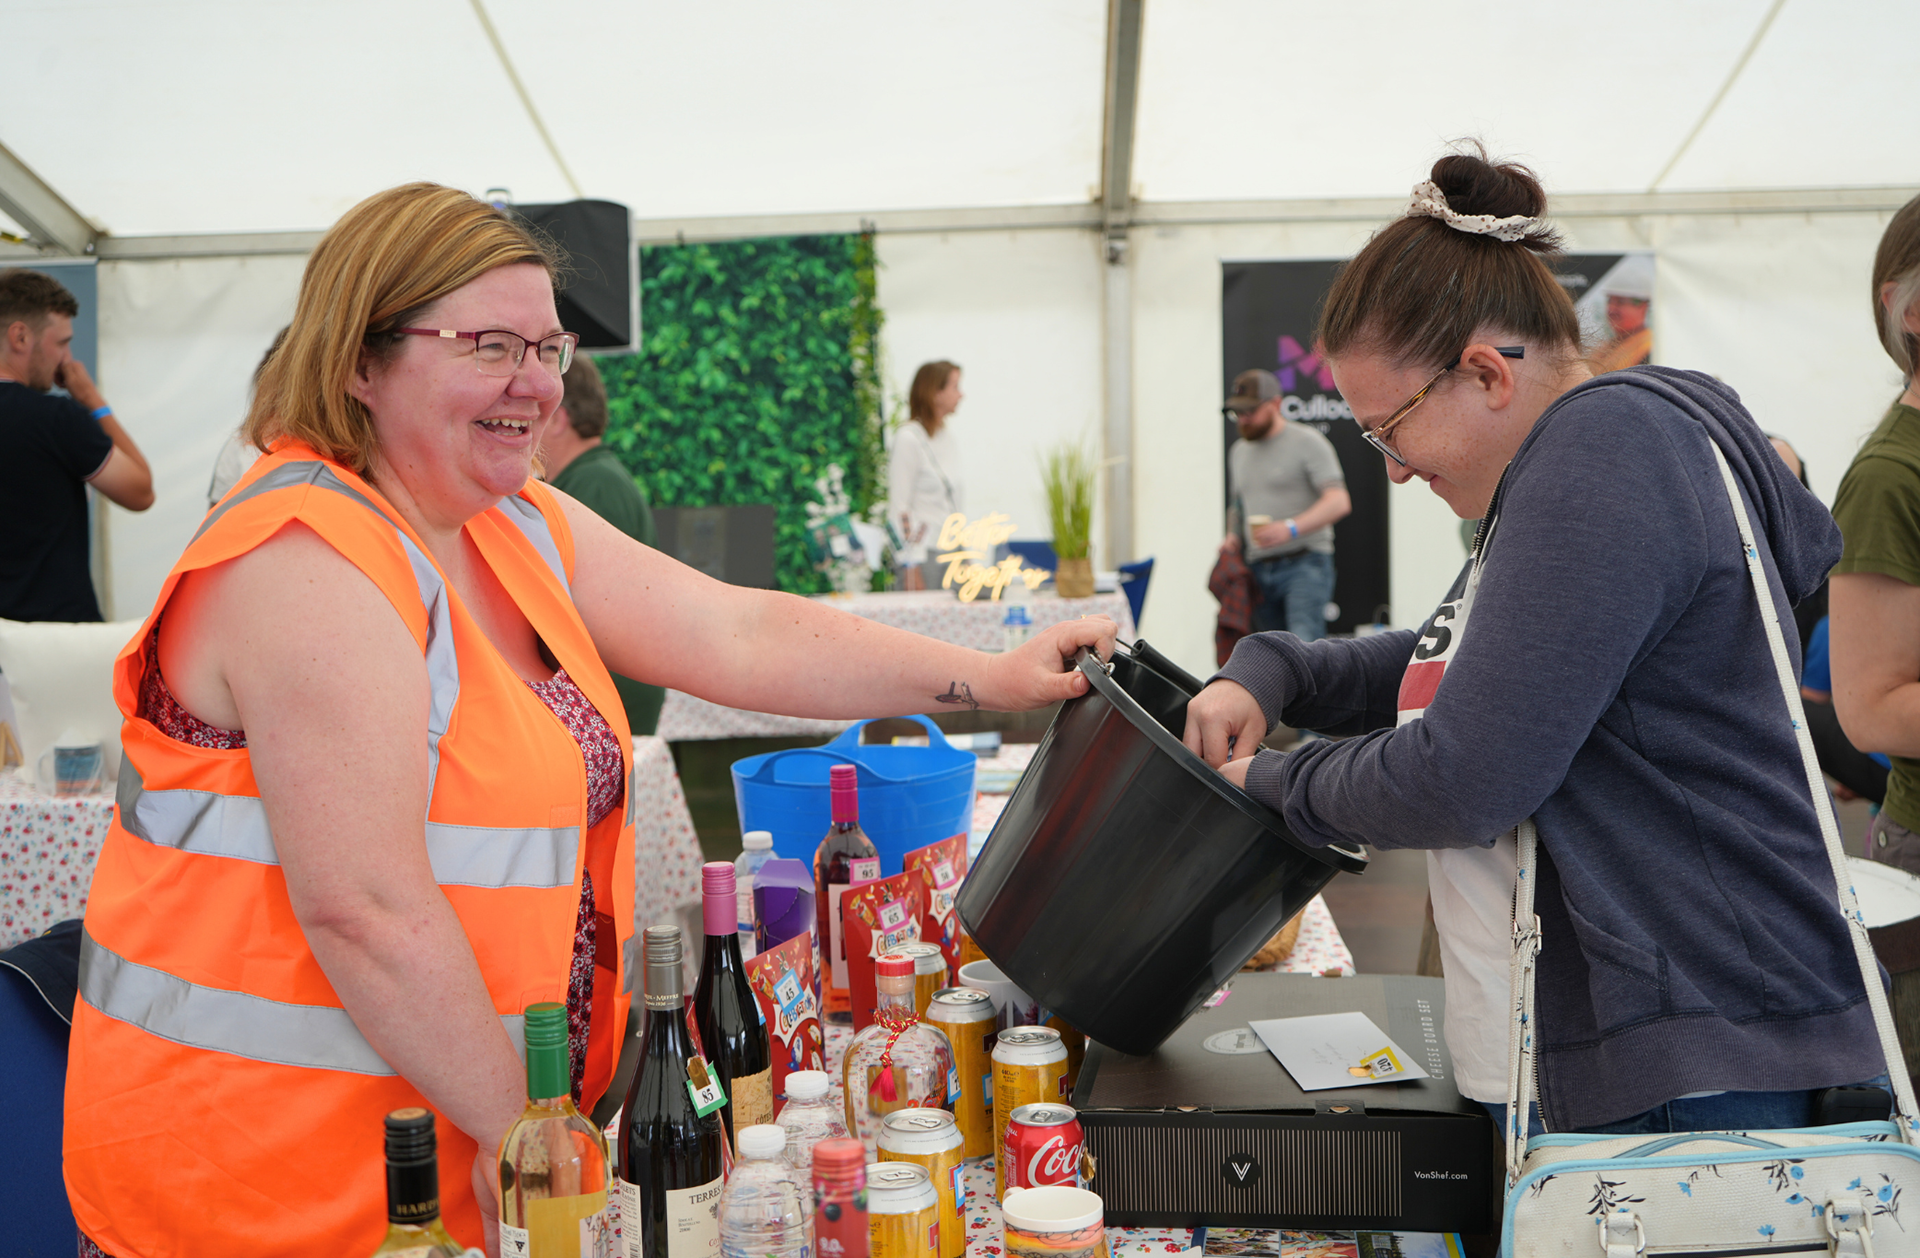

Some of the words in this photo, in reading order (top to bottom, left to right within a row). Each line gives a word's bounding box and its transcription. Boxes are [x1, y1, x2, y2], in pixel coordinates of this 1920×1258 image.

[862, 869, 874, 878] 95
[888, 913, 899, 924] 65
[785, 987, 795, 1001] 45
[1417, 999, 1431, 1014] SET
[1420, 1016, 1437, 1044] BOARD
[1426, 1047, 1445, 1080] CHEESE
[701, 1088, 714, 1104] 85
[1414, 1170, 1468, 1180] VonShef.com
[688, 1187, 720, 1205] TERRES
